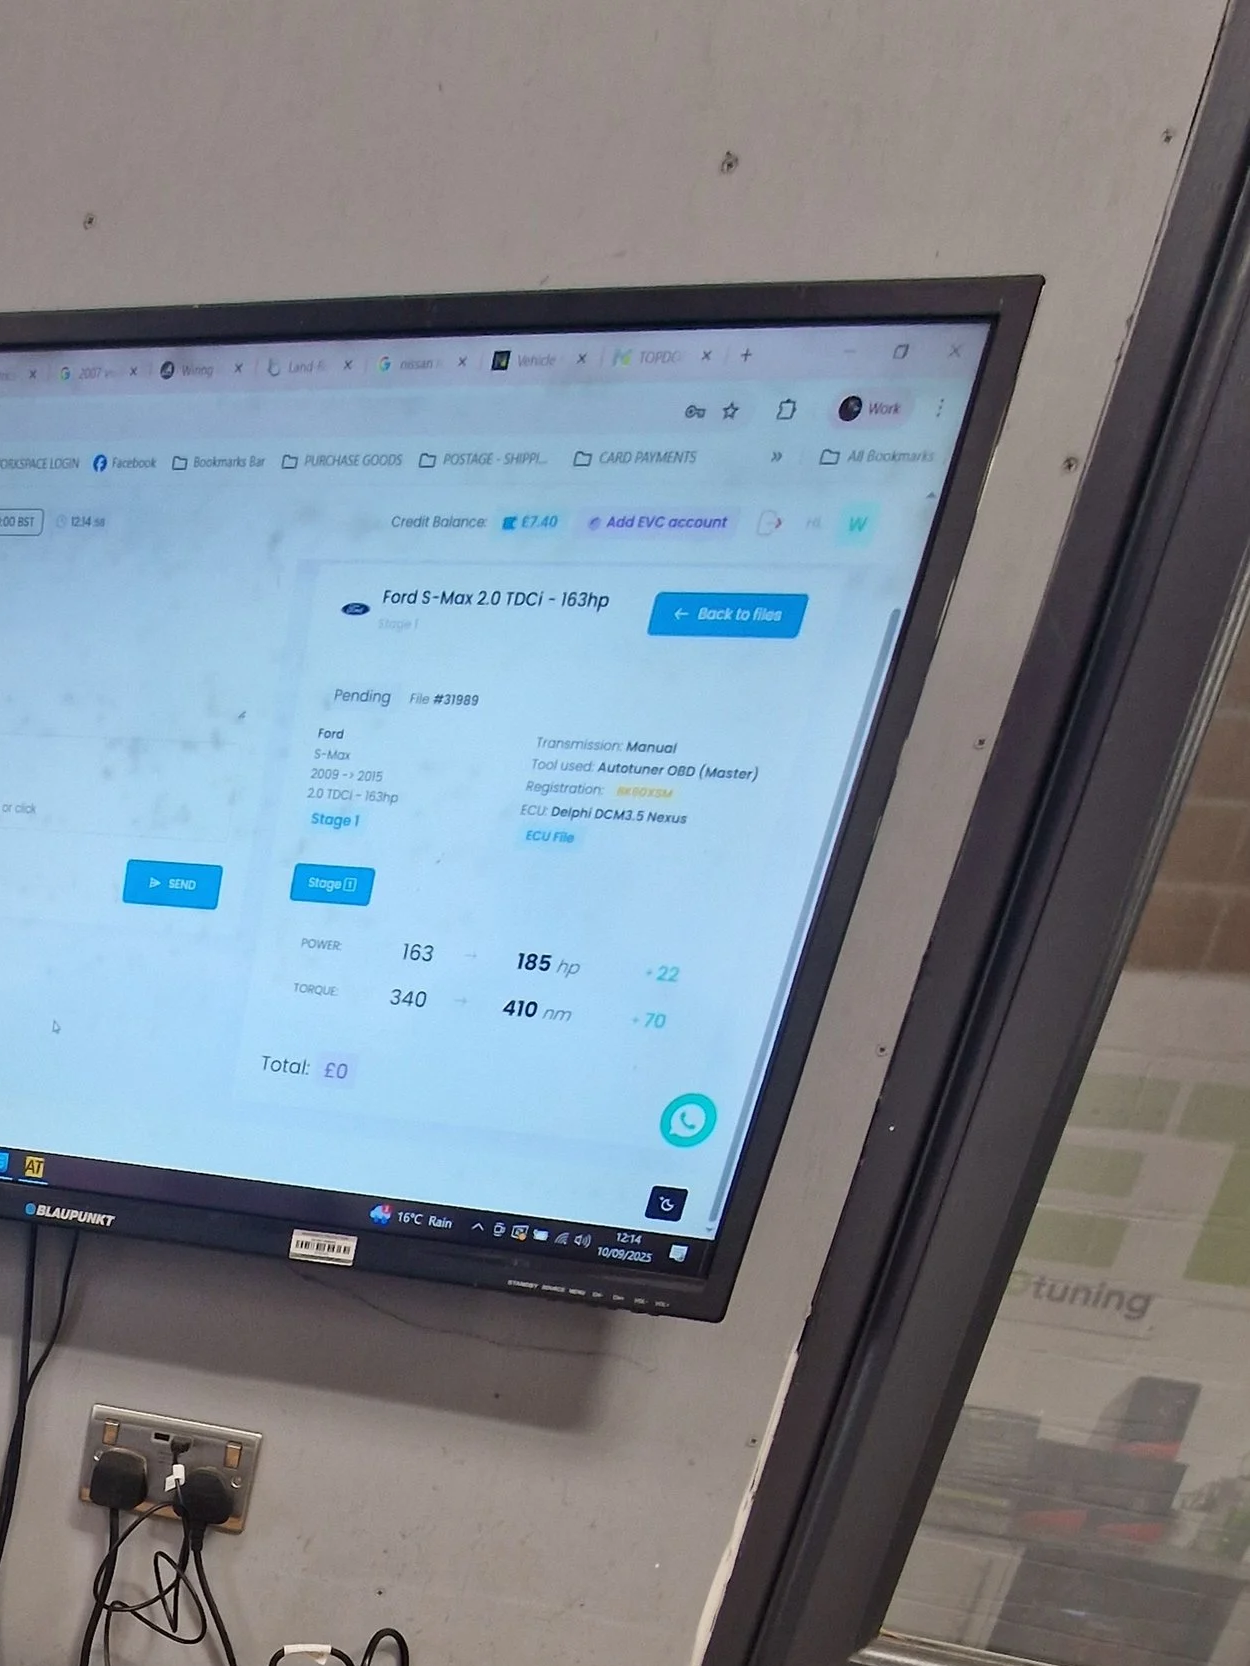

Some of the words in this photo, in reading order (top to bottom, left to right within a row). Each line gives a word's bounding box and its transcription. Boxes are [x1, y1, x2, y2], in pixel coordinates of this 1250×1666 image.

[868, 401, 902, 414] Work
[50, 456, 80, 470] LOGIN
[112, 456, 157, 470] Facebook
[193, 455, 246, 469] Bookmarks
[249, 455, 266, 468] Bar
[304, 453, 360, 467] PURCHASE
[362, 453, 403, 467] GOODS
[442, 452, 493, 466] POSTAGE
[598, 451, 632, 465] CARD
[634, 449, 698, 464] PAYMENTS
[847, 449, 865, 462] All
[866, 448, 935, 462] Bookmarks
[17, 514, 35, 528] BST
[391, 514, 430, 529] Credit
[432, 513, 488, 529] Balance:
[606, 515, 635, 529] Add
[637, 514, 665, 528] EVC
[668, 513, 728, 529] account
[382, 589, 417, 605] Ford
[421, 588, 475, 606] S-Max
[476, 590, 501, 606] 2.0
[505, 591, 544, 608] TDCi
[561, 590, 610, 612] 163hp
[697, 606, 732, 621] Back
[734, 606, 749, 621] to
[752, 606, 782, 622] files
[333, 688, 392, 707] Pending
[410, 692, 430, 705] File
[433, 693, 480, 706] #31989
[317, 728, 345, 740] Ford
[536, 736, 623, 753] Transmission:
[625, 740, 679, 755] Manual
[313, 748, 351, 761] S-Max
[310, 768, 340, 780] 2009
[356, 770, 384, 782] 2015
[532, 758, 558, 771] Tool
[560, 759, 595, 773] used:
[597, 761, 664, 777] Autotuner
[667, 764, 697, 777] OBD
[698, 764, 760, 783] (Master)
[306, 787, 325, 799] 2.0
[326, 788, 354, 801] TDCi
[364, 789, 400, 806] 163hp
[525, 780, 605, 797] Registration:
[1, 802, 13, 813] or
[14, 801, 37, 815] click
[520, 803, 549, 817] ECU:
[551, 805, 593, 822] Delphi
[594, 808, 645, 822] DCM3.5
[646, 811, 688, 825] Nexus
[311, 812, 352, 829] Stage
[525, 829, 551, 842] ECU
[553, 830, 575, 844] File
[168, 877, 197, 891] SEND
[308, 876, 342, 893] Stage
[402, 943, 435, 962] 163
[516, 952, 553, 973] 185
[555, 958, 581, 978] hp
[389, 989, 427, 1008] 340
[501, 999, 539, 1018] 410
[541, 1007, 573, 1023] nm
[261, 1054, 310, 1076] Total:
[323, 1061, 349, 1080] £0
[25, 1160, 44, 1175] AT
[36, 1203, 117, 1227] BLAUPUNKT
[396, 1210, 423, 1226] 16°C
[428, 1213, 453, 1230] Rain
[616, 1232, 643, 1245] 12:14
[597, 1246, 654, 1263] 10/09/2025
